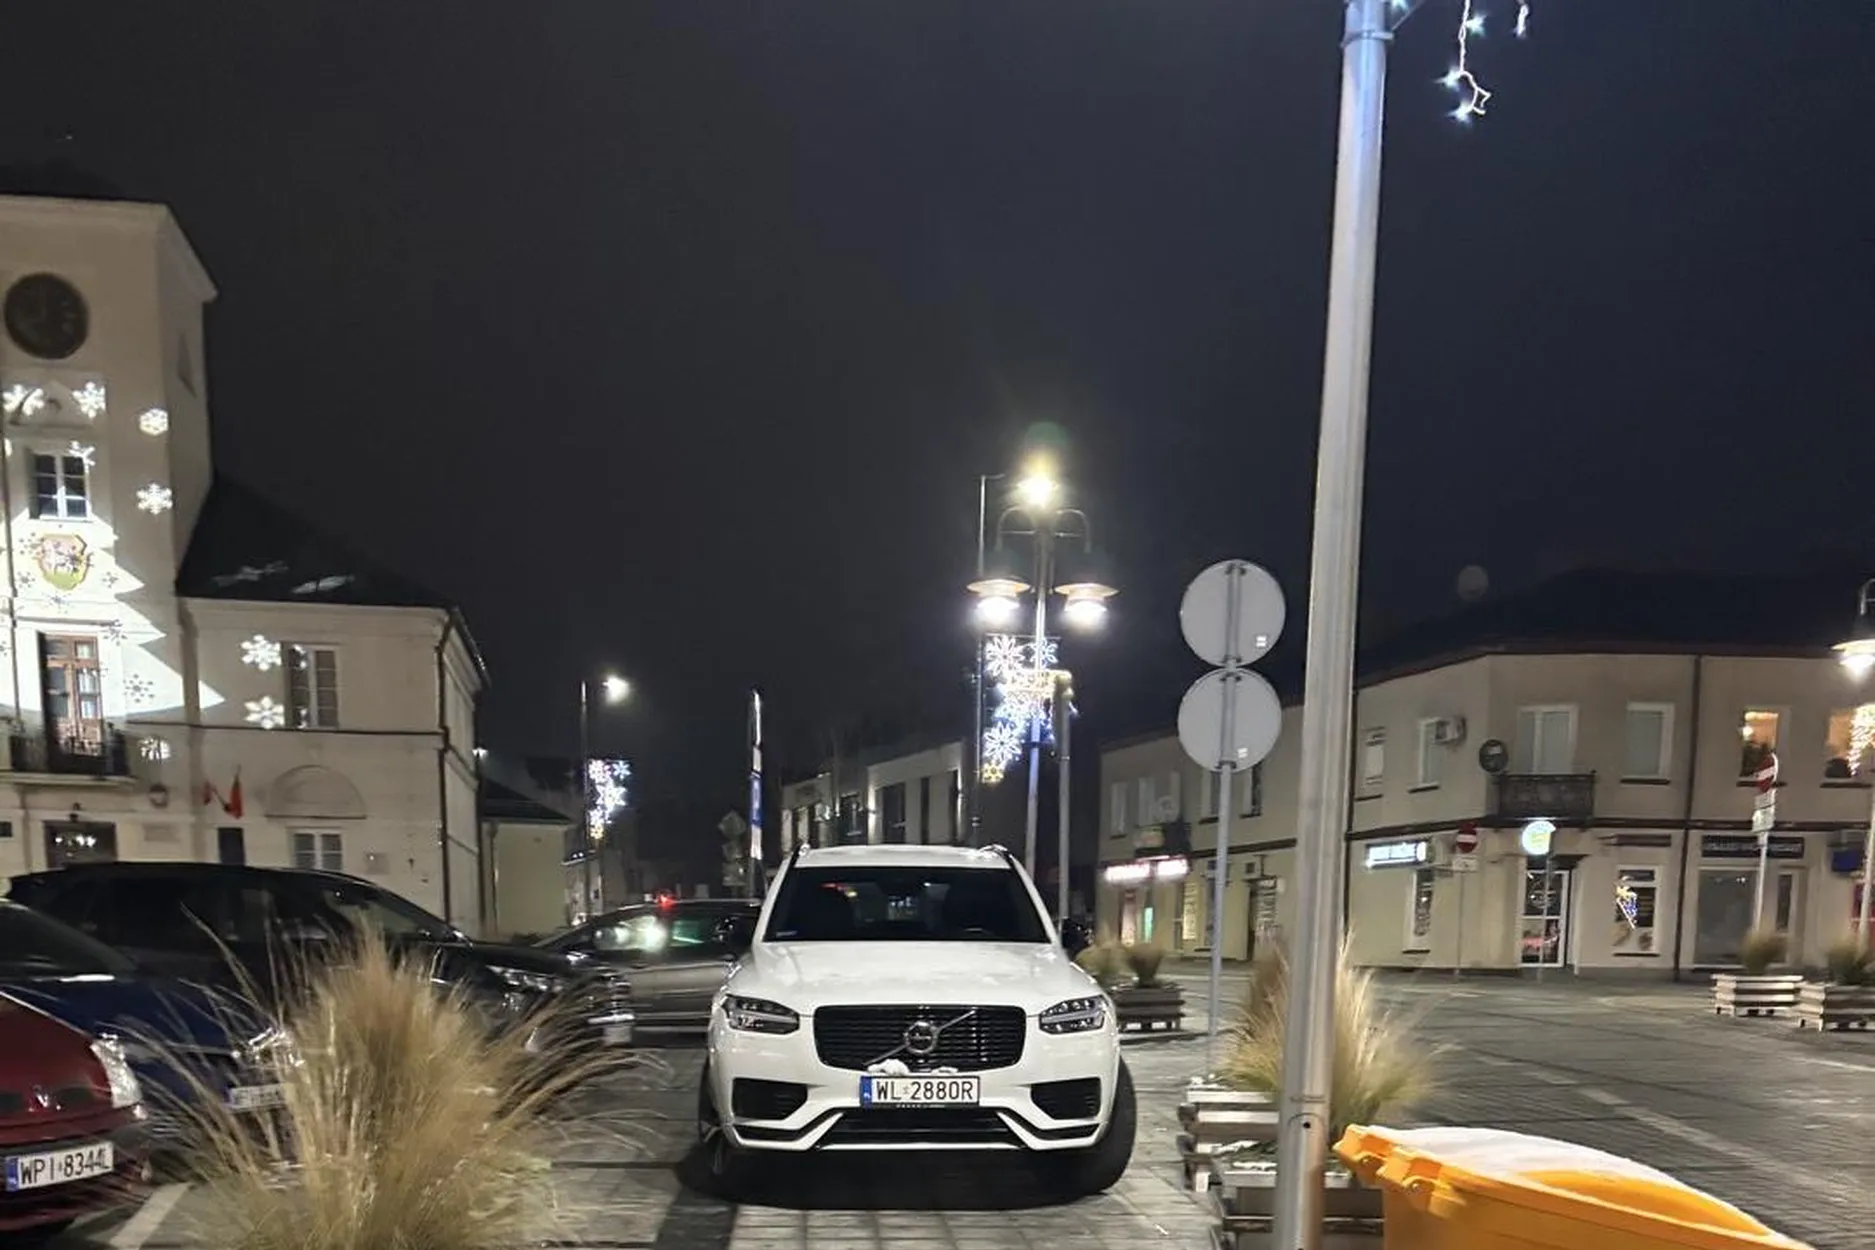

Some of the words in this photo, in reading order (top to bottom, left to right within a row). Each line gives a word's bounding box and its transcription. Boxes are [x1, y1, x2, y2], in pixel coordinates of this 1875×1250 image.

[876, 1081, 902, 1100] WL
[911, 1081, 973, 1100] 2880R
[20, 1157, 54, 1185] WPI
